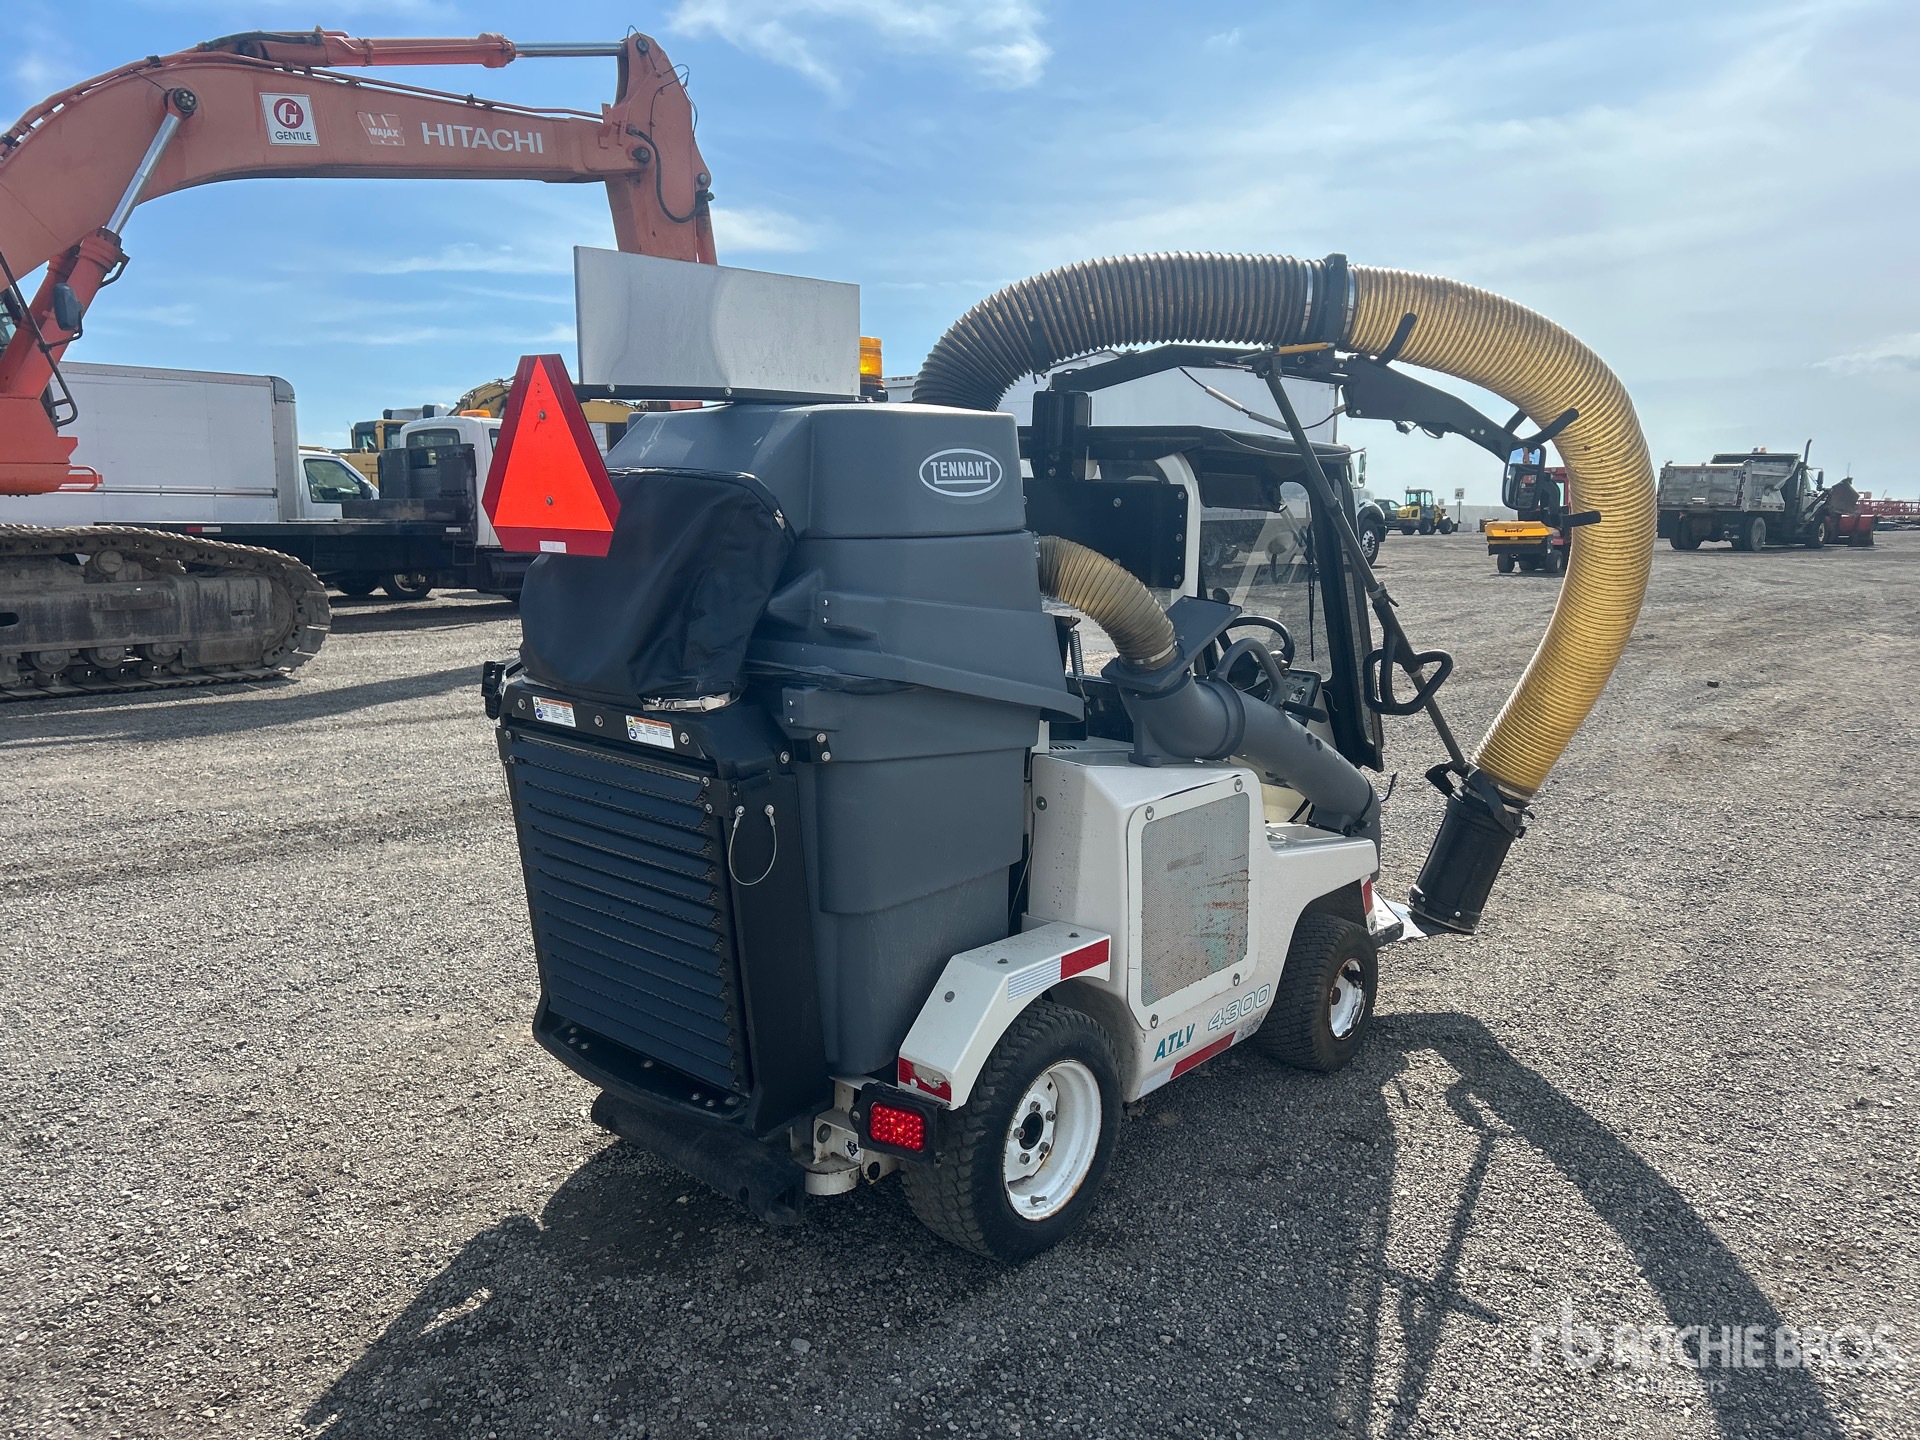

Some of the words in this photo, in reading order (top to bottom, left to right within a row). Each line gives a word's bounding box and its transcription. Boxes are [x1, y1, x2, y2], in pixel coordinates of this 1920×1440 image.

[275, 131, 311, 140] GENTILE
[368, 126, 399, 138] WAJAX
[422, 122, 543, 153] HITACHI
[930, 461, 991, 484] TENNANT
[1153, 1023, 1196, 1062] ATLV
[1207, 983, 1271, 1031] 4300
